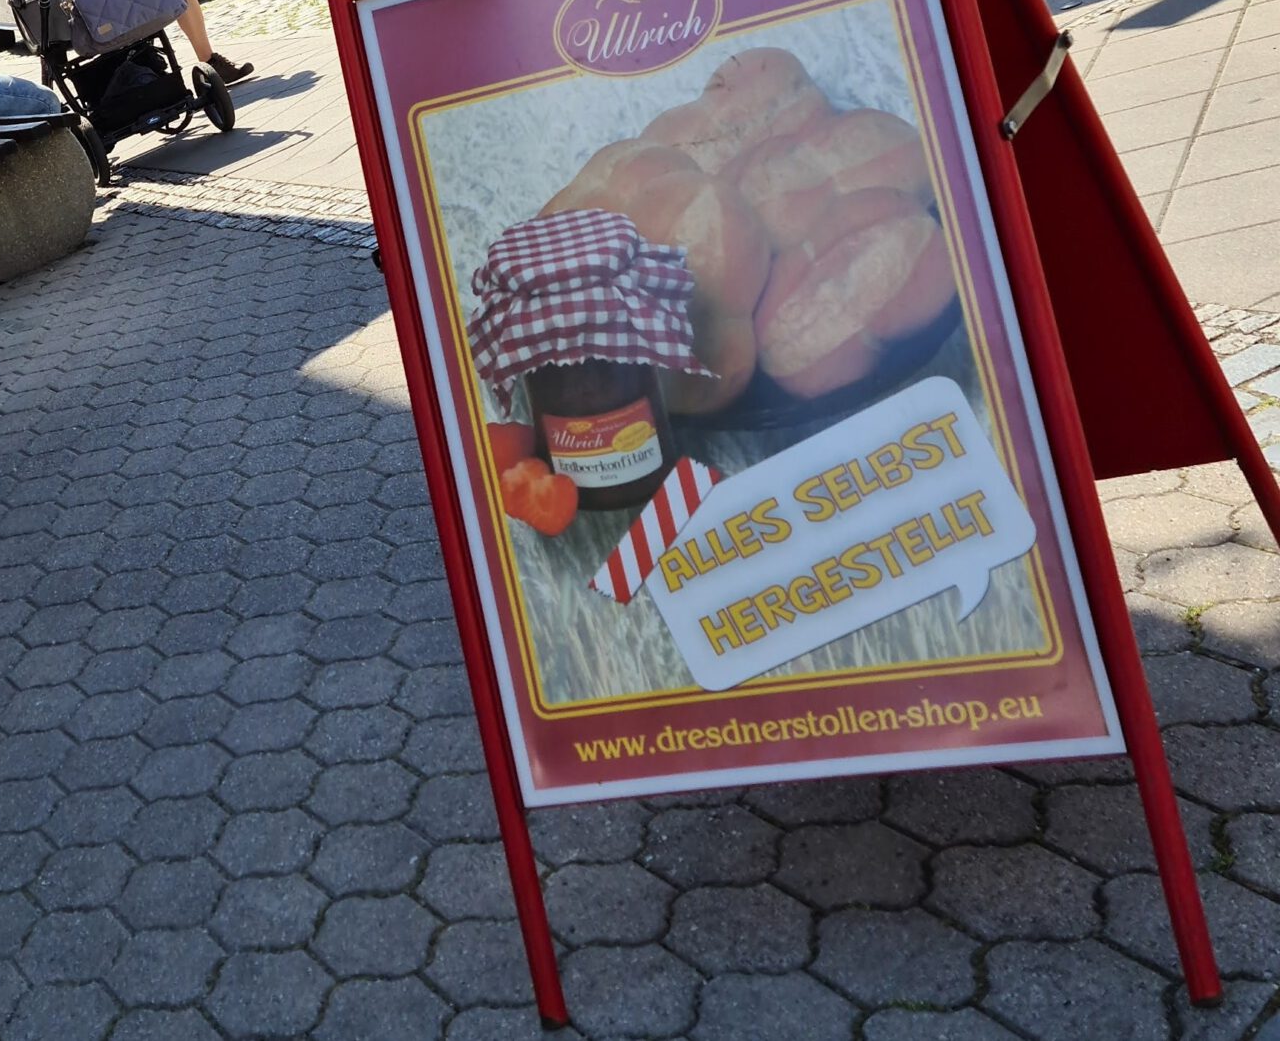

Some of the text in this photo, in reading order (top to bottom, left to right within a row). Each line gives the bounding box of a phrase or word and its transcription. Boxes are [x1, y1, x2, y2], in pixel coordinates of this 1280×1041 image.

[551, 430, 604, 448] Ullrich
[558, 447, 655, 473] Erdbeerkonfitüre
[658, 412, 967, 593] ALLES SELBST
[699, 490, 995, 656] HERGESTELLT
[574, 695, 1042, 762] www.dresdnerstollen-shop.eu
